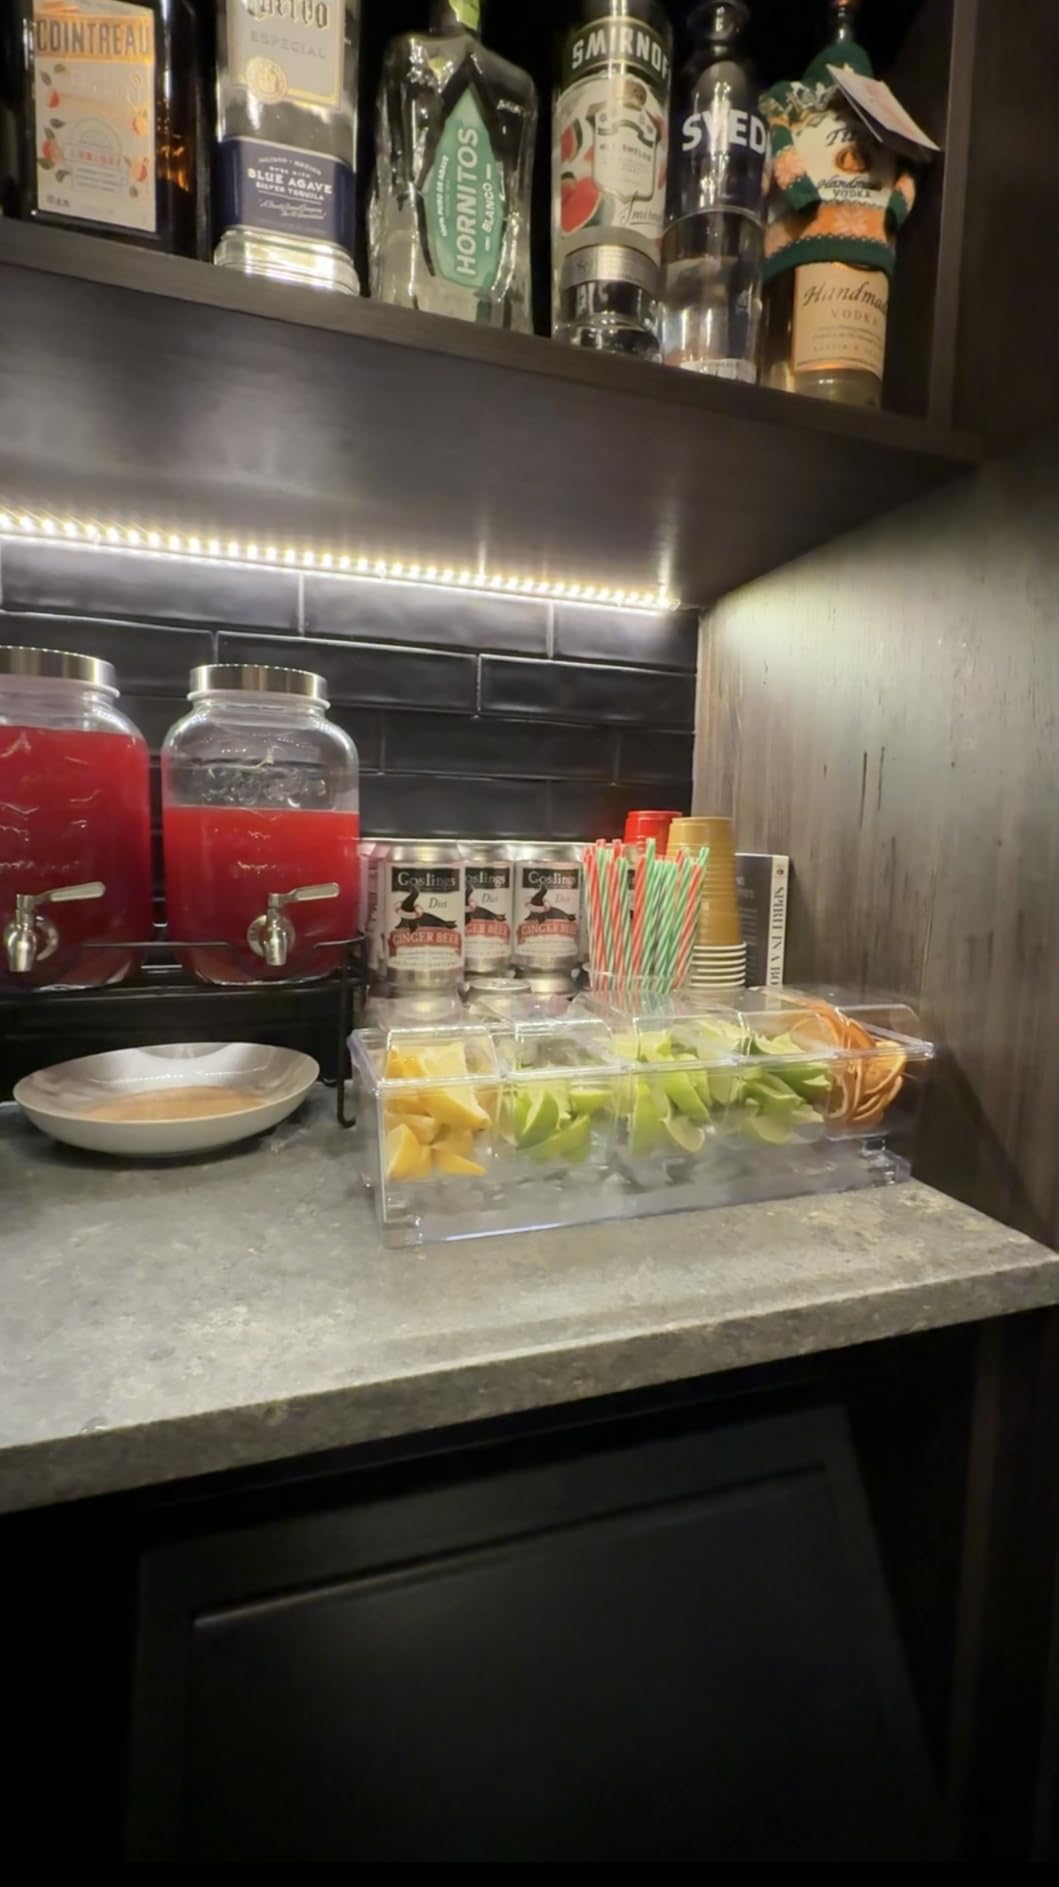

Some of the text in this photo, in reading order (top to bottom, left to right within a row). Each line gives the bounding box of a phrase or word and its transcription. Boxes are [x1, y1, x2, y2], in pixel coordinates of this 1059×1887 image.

[36, 19, 149, 55] COINTREAU
[250, 30, 327, 59] ESPECIAL
[247, 167, 333, 195] BLUE AGAVE
[255, 181, 325, 201] SILVER TEQUILA
[456, 127, 478, 275] HORNITOS
[481, 182, 496, 233] BLANCO
[802, 281, 887, 316] Handma
[831, 307, 878, 327] VODKA
[397, 872, 456, 890] Goslings
[466, 871, 505, 888] oslings
[771, 886, 785, 929] SPIRIT
[392, 930, 434, 946] GINGER
[770, 936, 782, 950] IN
